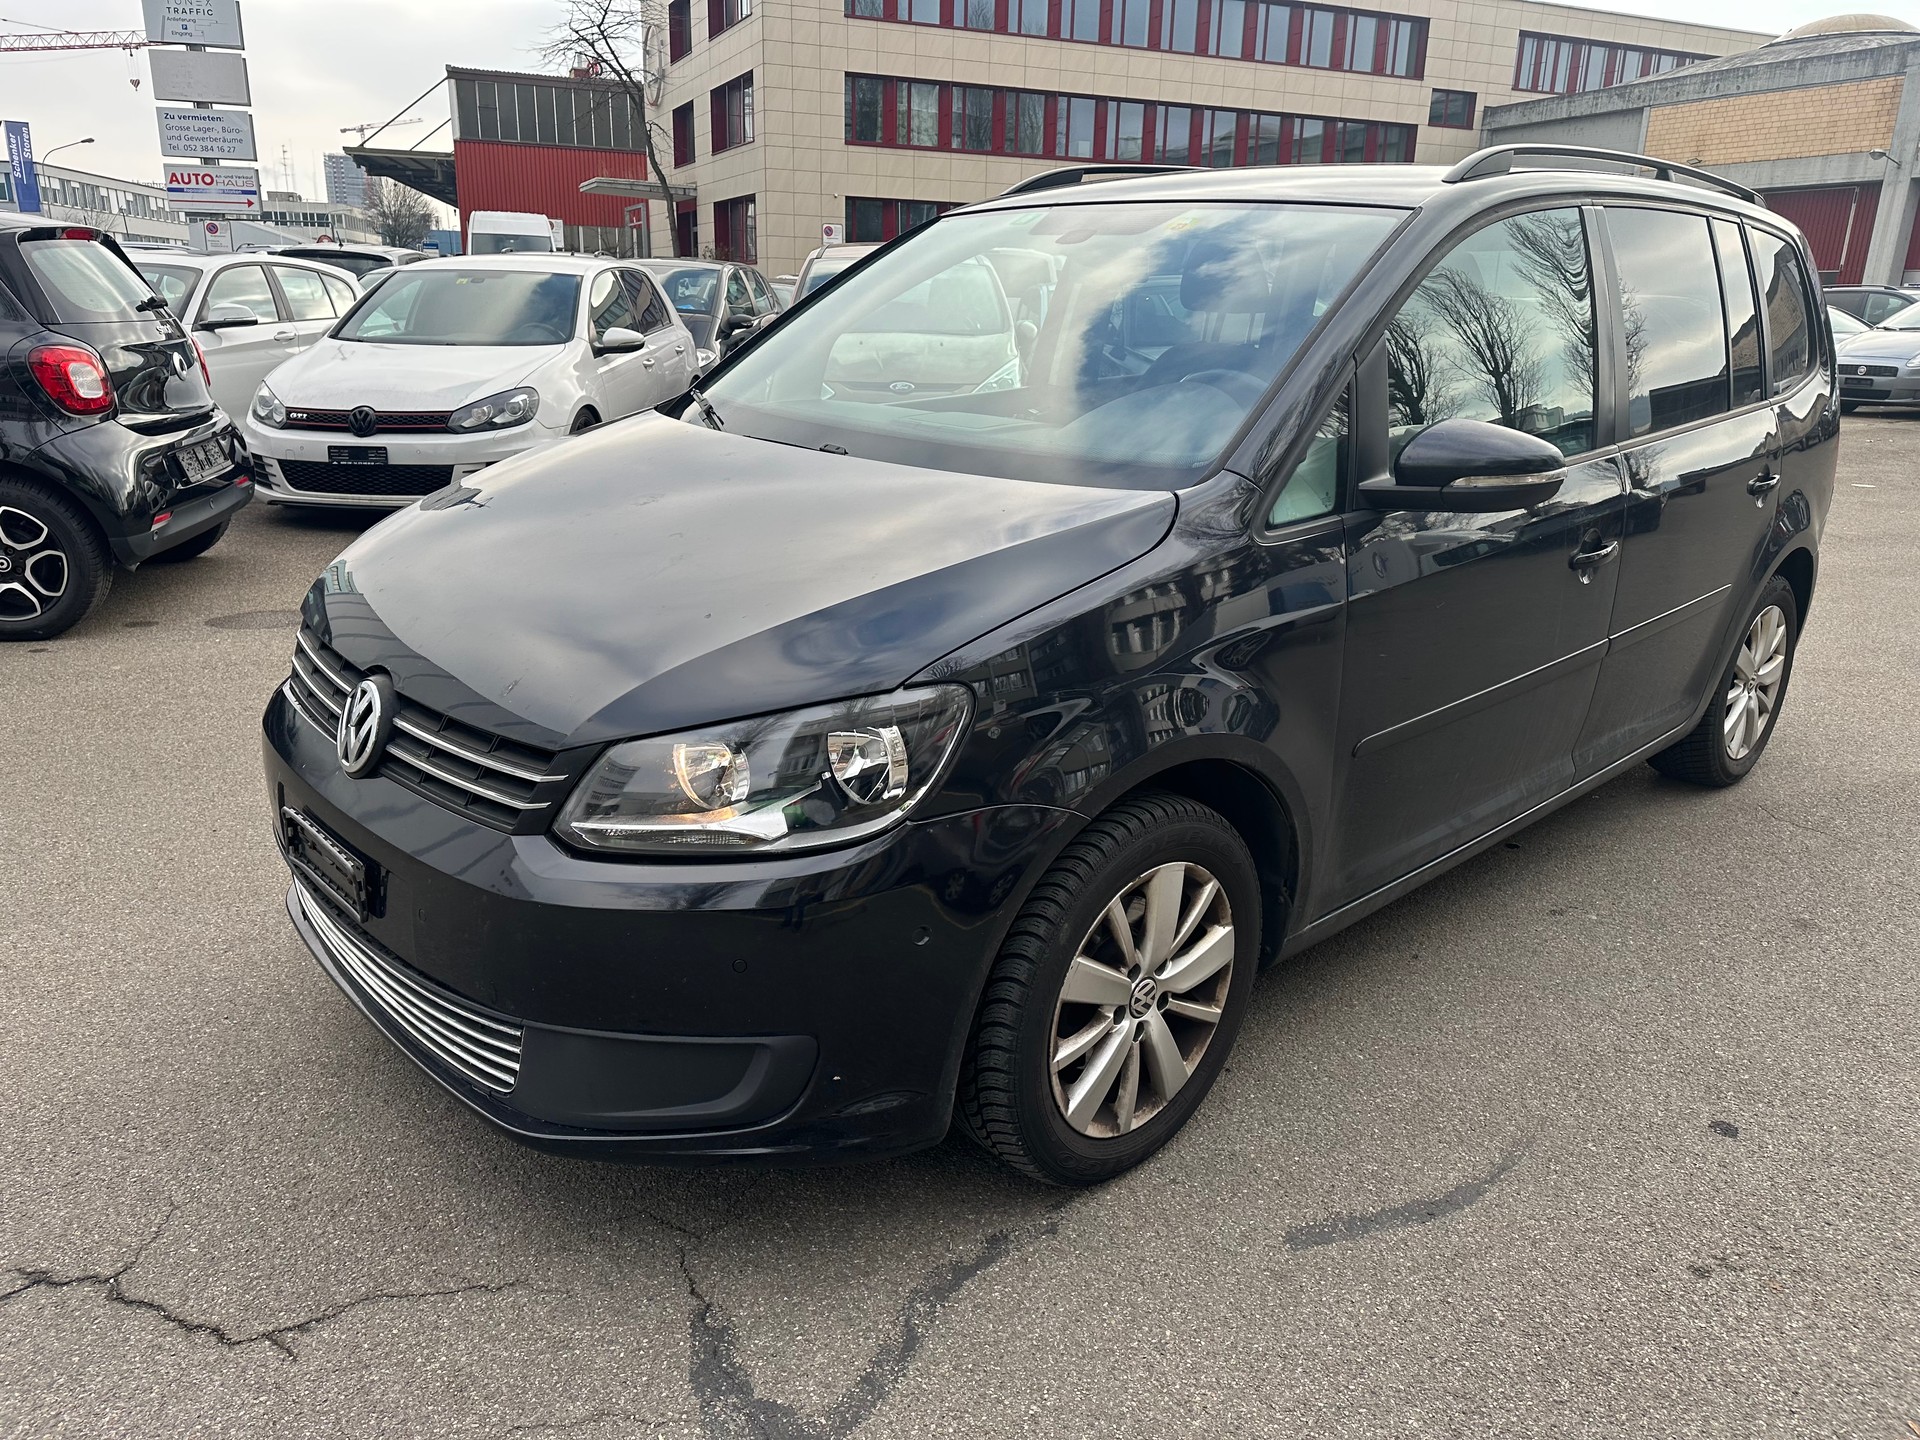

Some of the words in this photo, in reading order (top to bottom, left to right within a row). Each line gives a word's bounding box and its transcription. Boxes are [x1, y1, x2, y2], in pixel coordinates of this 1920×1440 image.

[166, 7, 214, 16] TRAFFIC
[166, 16, 197, 24] Anlieferung
[163, 112, 175, 120] Zu
[177, 113, 225, 122] vermieten:
[165, 123, 191, 132] Grosse
[192, 124, 220, 134] Lager-,
[221, 125, 243, 134] Büro-
[21, 126, 32, 159] Storen
[166, 133, 182, 141] und
[183, 134, 244, 144] Gewerberäume
[168, 143, 181, 151] Tel.
[183, 144, 198, 152] 052
[200, 144, 214, 152] 384
[216, 145, 225, 153] 16
[9, 132, 22, 179] Schenker
[168, 172, 215, 186] AUTO
[215, 179, 255, 188] HAUS
[289, 412, 308, 420] GTI
